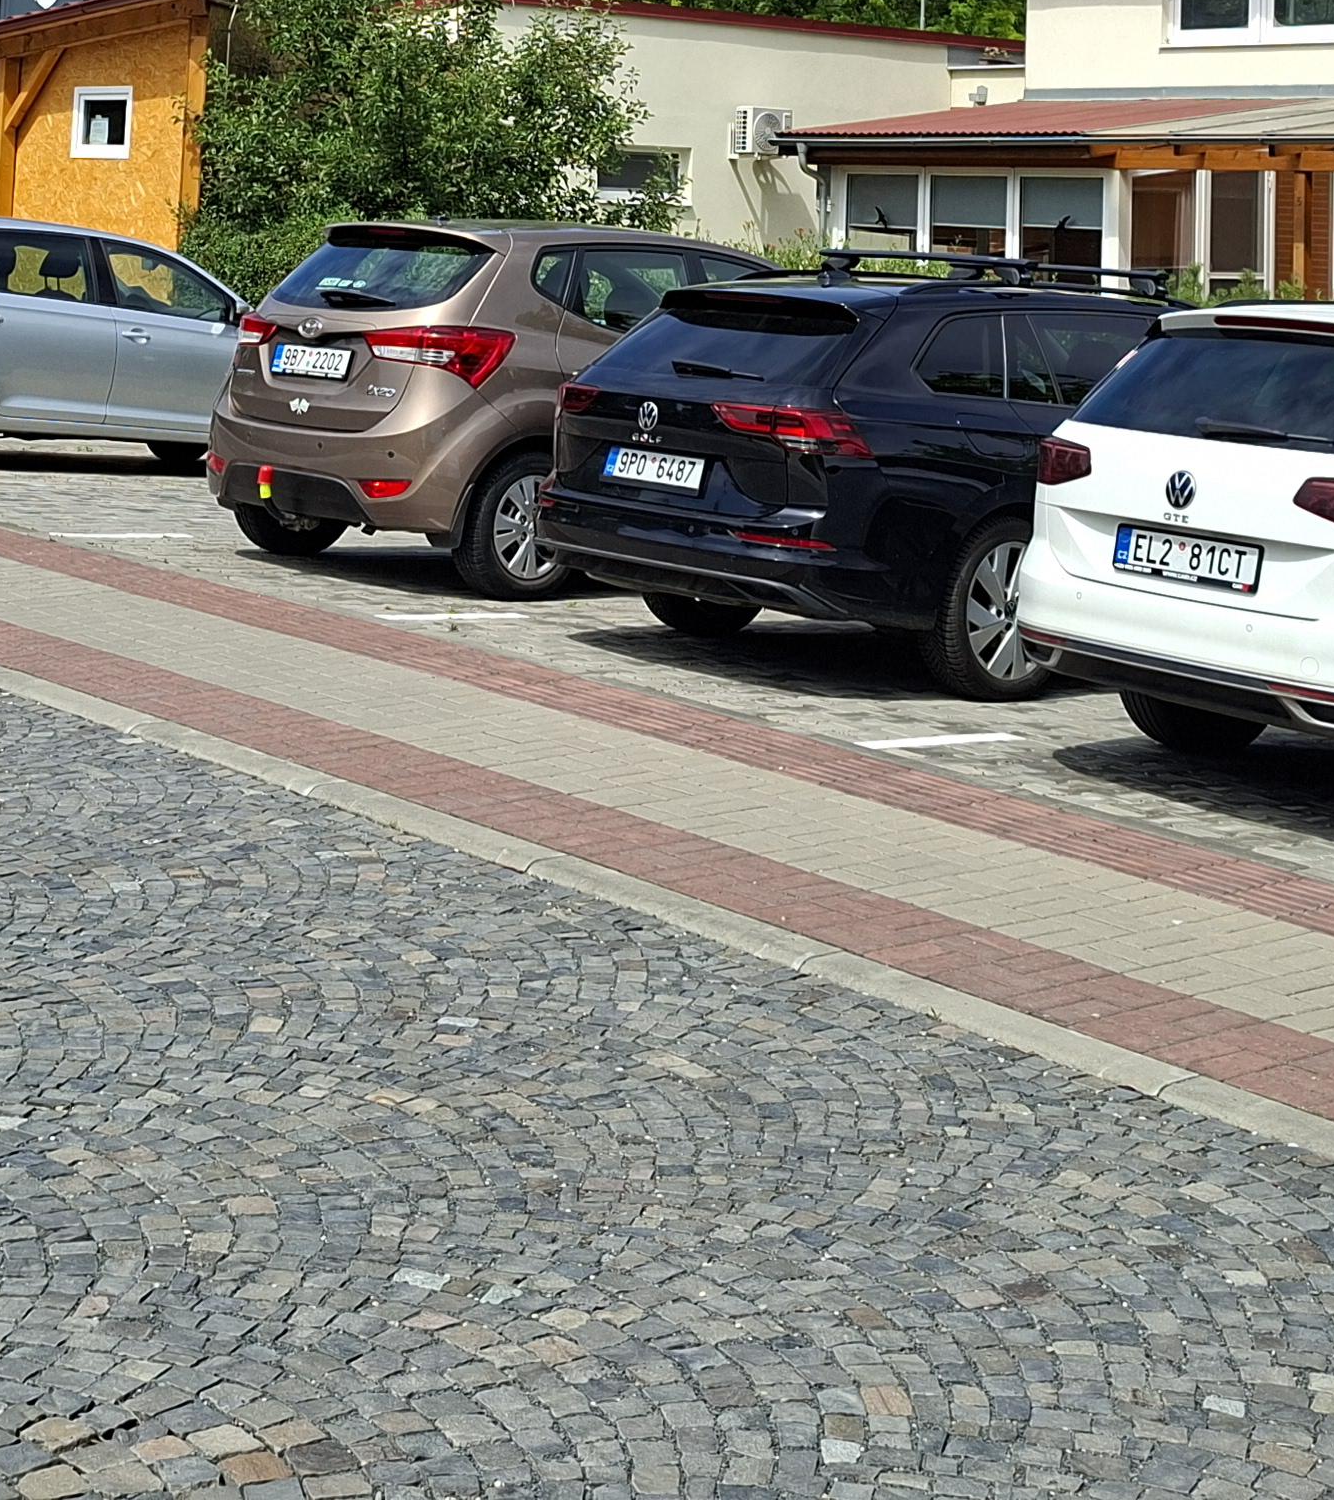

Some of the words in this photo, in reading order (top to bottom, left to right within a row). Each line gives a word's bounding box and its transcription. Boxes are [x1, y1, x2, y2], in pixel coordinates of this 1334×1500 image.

[283, 348, 306, 367] 9B7
[312, 351, 344, 372] 2202
[631, 432, 663, 443] GOLF
[656, 457, 696, 483] 6487
[1163, 512, 1189, 524] GTE
[1133, 534, 1172, 567] EL2
[1189, 542, 1248, 580] 81CT
